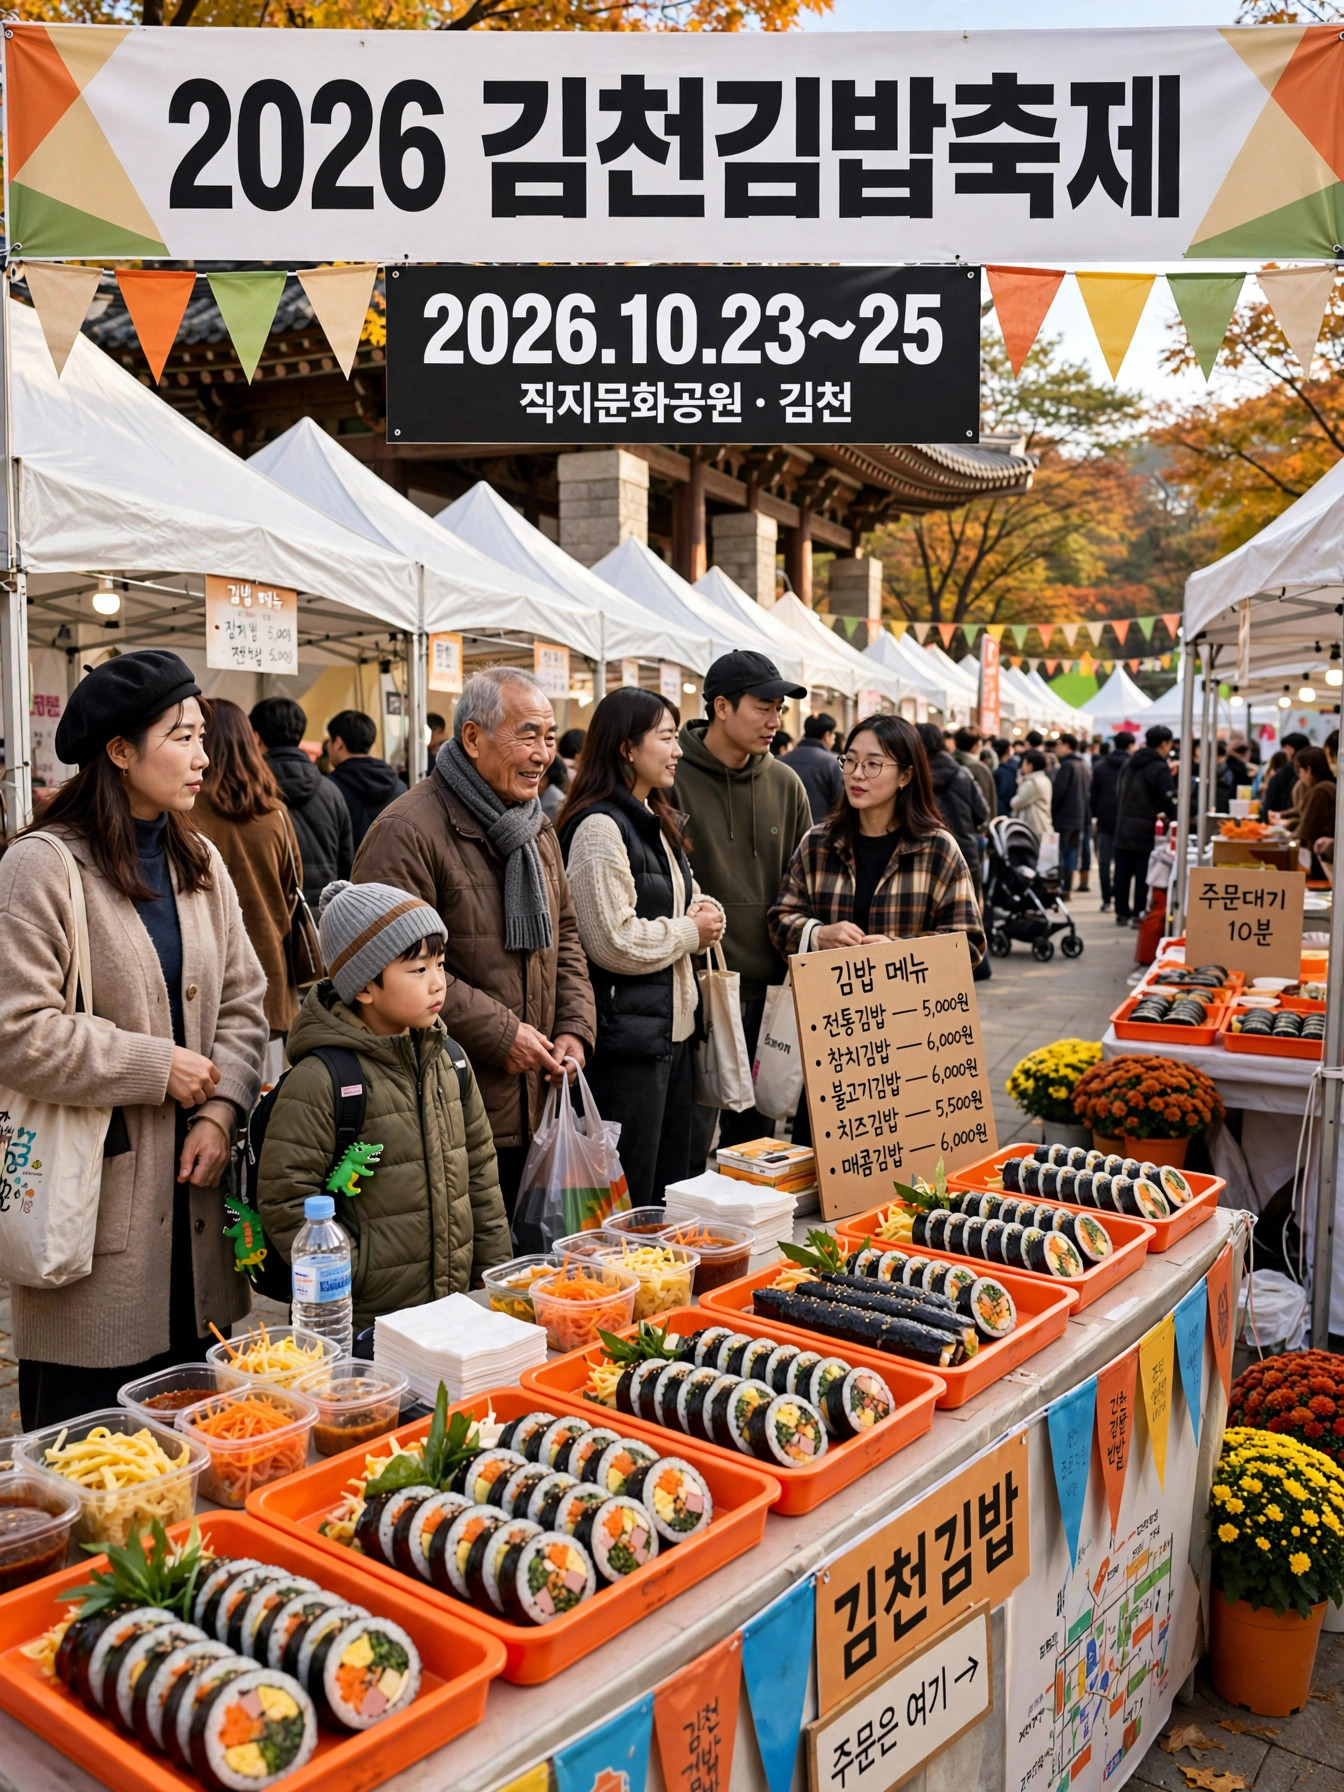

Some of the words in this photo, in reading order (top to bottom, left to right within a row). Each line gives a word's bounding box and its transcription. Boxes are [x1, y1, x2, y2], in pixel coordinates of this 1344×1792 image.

[168, 77, 446, 213] 2026
[481, 72, 1181, 219] 김천김밥축제
[423, 292, 943, 365] 2026.10.23~25
[519, 381, 742, 424] 직지문화공원
[778, 381, 852, 424] 김천
[1198, 883, 1286, 912] 주문대기
[1228, 918, 1274, 947] 10분
[830, 957, 877, 997] 김밥
[885, 952, 929, 985] 메뉴
[822, 1003, 887, 1038] 전통김밥
[921, 992, 970, 1018] 5,000원
[827, 1038, 891, 1073] 참치김밥
[926, 1024, 975, 1052] 6,000원
[831, 1070, 902, 1111] 불고기김밥
[931, 1057, 979, 1084] 6,000원
[836, 1106, 900, 1141] 치즈김밥
[935, 1090, 984, 1118] 5,500원
[841, 1141, 904, 1177] 매콤김밥
[940, 1122, 989, 1152] 6,000원
[834, 1470, 1019, 1680] 김천김밥
[831, 1706, 899, 1789] 주문은
[906, 1666, 947, 1727] 여기
